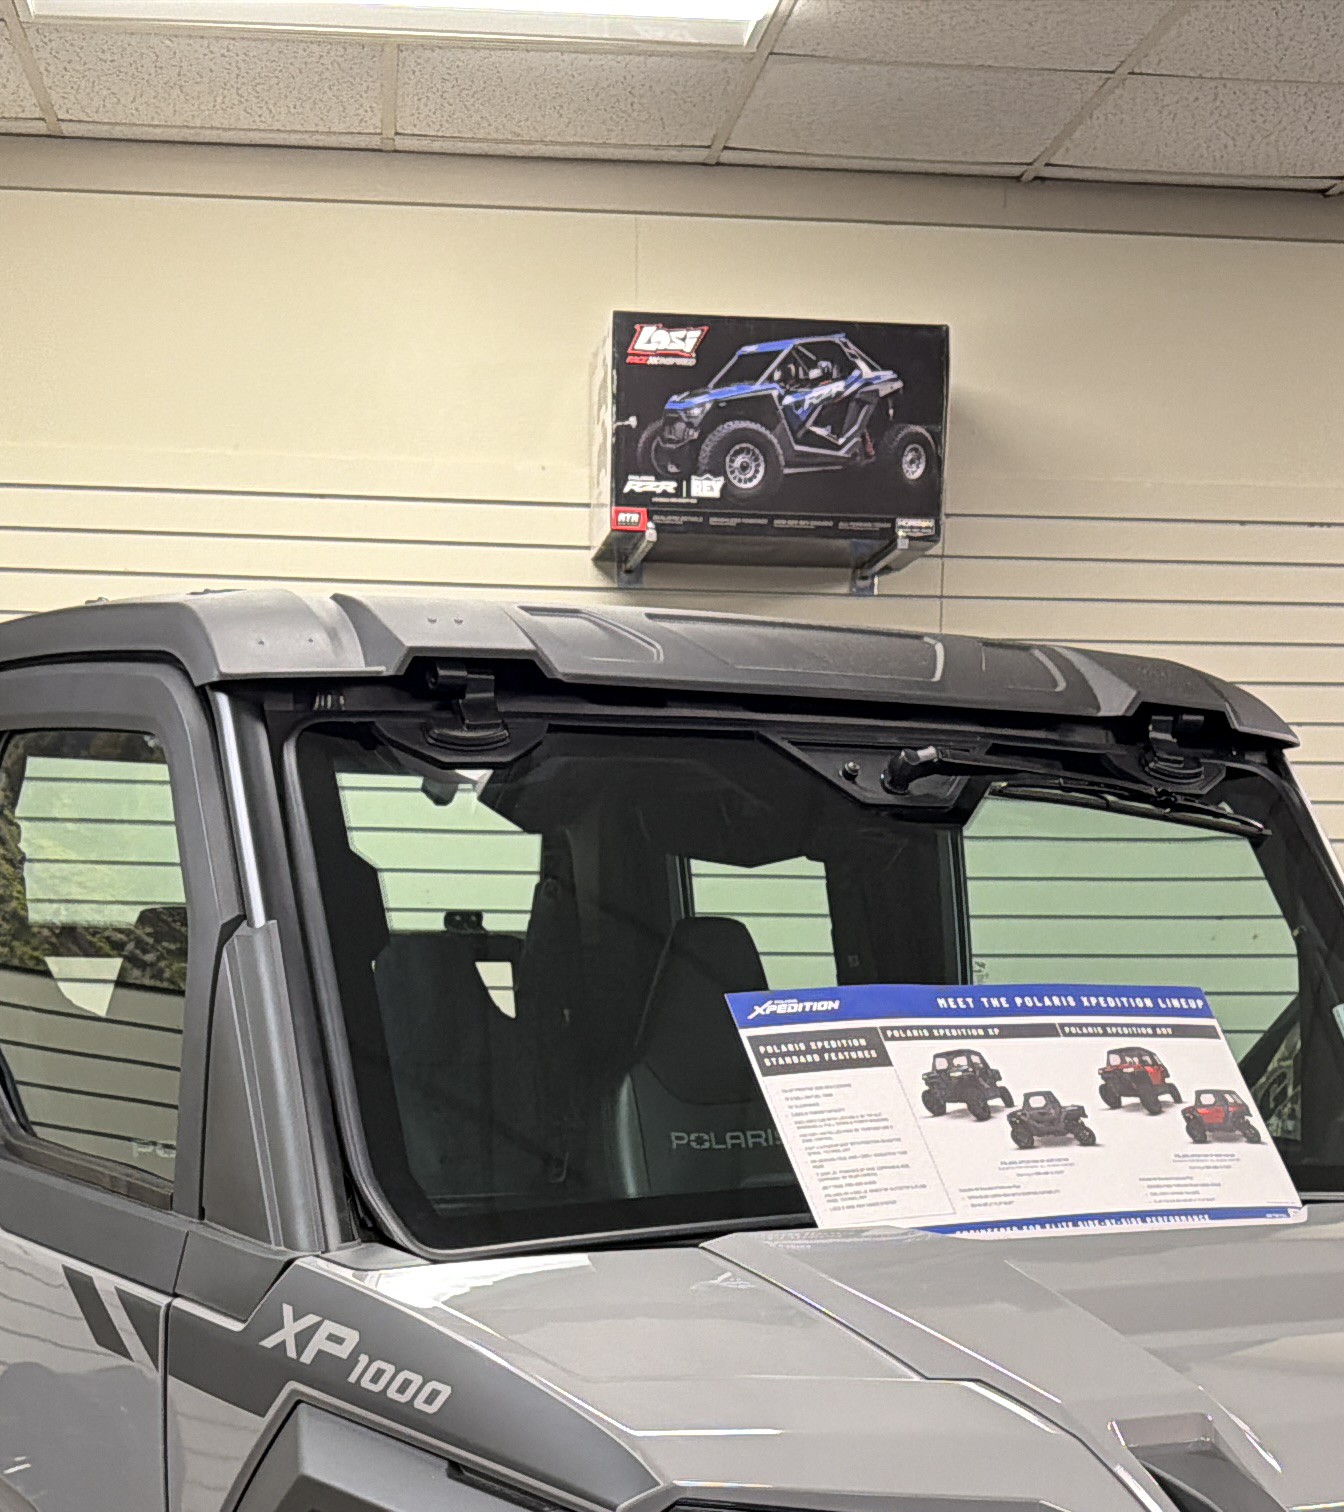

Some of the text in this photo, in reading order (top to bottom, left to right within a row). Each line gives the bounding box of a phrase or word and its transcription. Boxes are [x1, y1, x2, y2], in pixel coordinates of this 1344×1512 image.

[747, 998, 840, 1019] XPEDITION
[936, 995, 1204, 1009] MEET THE POLARIS XPEDITION LINEUP
[886, 1028, 930, 1038] POLARIS
[932, 1027, 985, 1037] XPEDITION
[1063, 1026, 1104, 1035] POLARIS
[758, 1038, 867, 1054] POLARIS XPEDITION
[763, 1050, 878, 1067] STANDARD FEATURES
[259, 1303, 452, 1414] XP 1000
